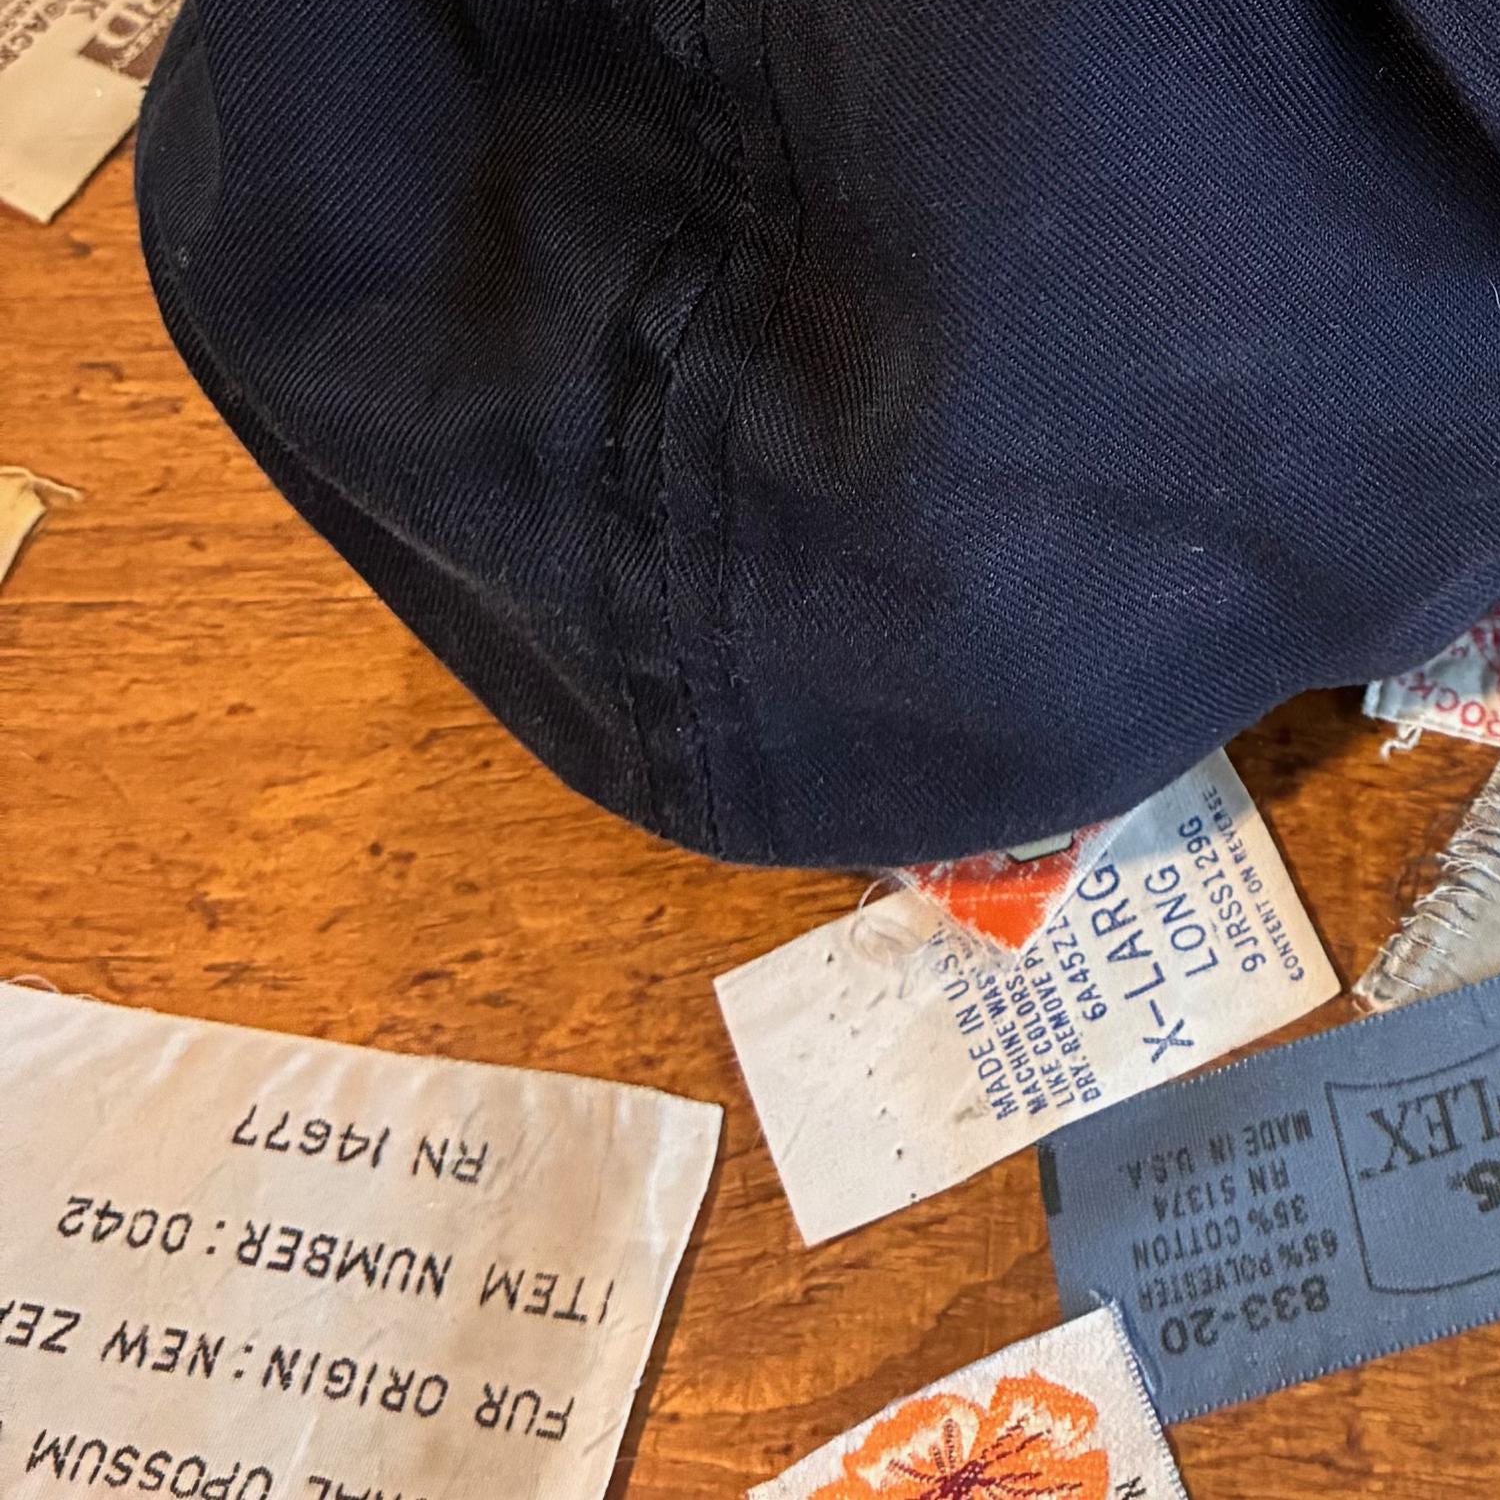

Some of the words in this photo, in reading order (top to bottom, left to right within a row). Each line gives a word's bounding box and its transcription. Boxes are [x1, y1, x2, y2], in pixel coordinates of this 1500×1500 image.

[1199, 781, 1250, 867] REVERSE
[1177, 815, 1260, 973] 9JRSS129G
[1238, 863, 1264, 896] ON
[1144, 867, 1217, 979] LONG
[1254, 893, 1308, 988] CONTENT
[1075, 852, 1196, 1064] X-LARG
[952, 1003, 984, 1035] IN
[1032, 968, 1082, 1057] REMOVE
[967, 1037, 1021, 1124] MADE
[995, 1016, 1051, 1118] MACHINE
[1042, 1057, 1077, 1109] LIKE
[1068, 1051, 1103, 1105] DRY.
[231, 1104, 391, 1170] 14677
[413, 1135, 491, 1185] RN
[1206, 1132, 1240, 1168] IN
[1240, 1109, 1316, 1159] MADE
[1149, 1173, 1240, 1225] 51374
[1245, 1158, 1292, 1197] RN
[1127, 1212, 1244, 1272] COTTON
[1244, 1192, 1313, 1239] 35%
[1275, 1227, 1343, 1273] 65%
[479, 1262, 614, 1327] ITEM
[1134, 1247, 1277, 1315] POLYESTER
[0, 1302, 80, 1354] ZE
[1154, 1272, 1335, 1359] 833-20
[474, 1382, 576, 1441] FUR
